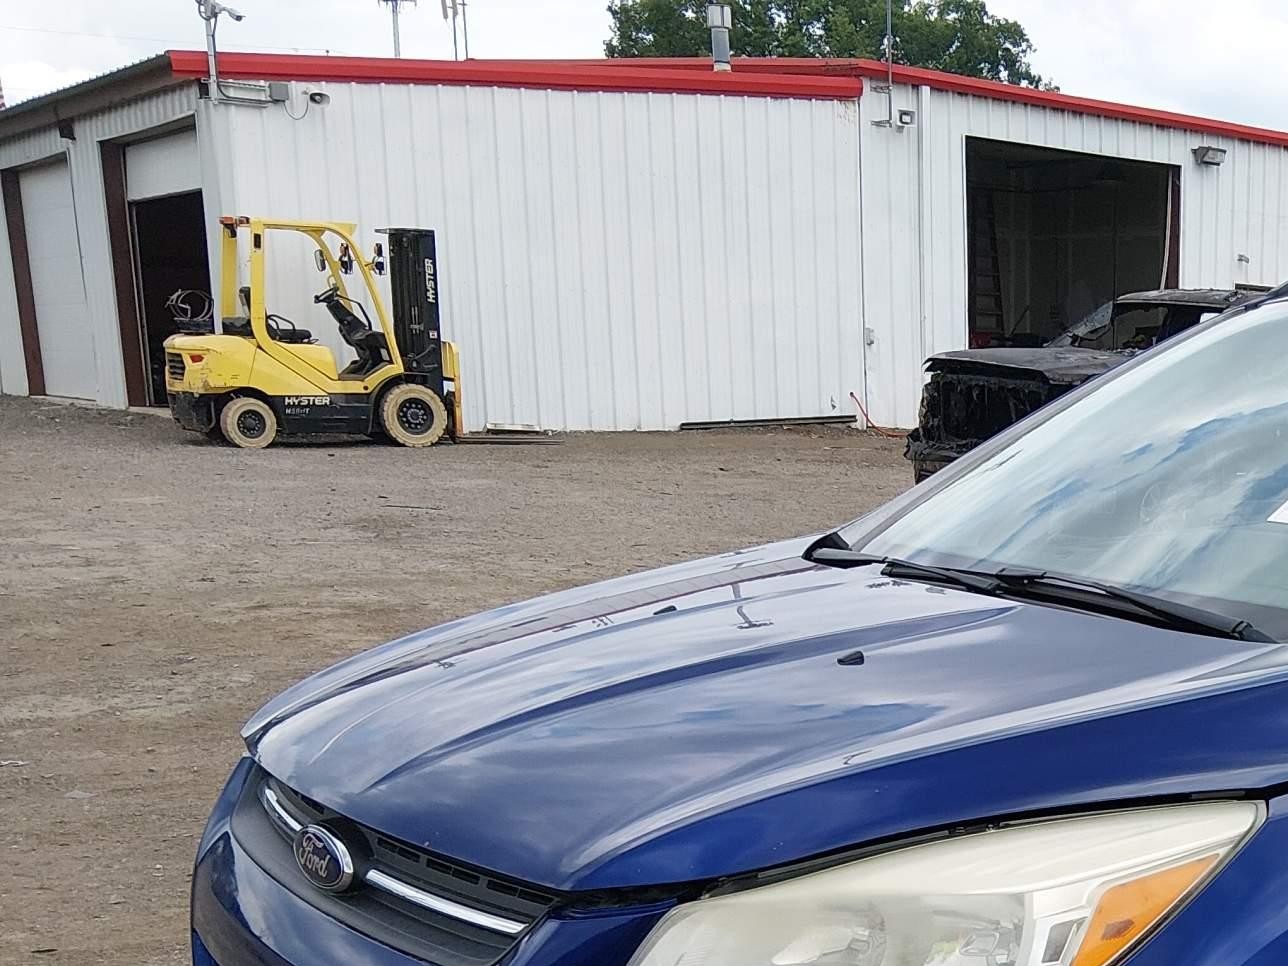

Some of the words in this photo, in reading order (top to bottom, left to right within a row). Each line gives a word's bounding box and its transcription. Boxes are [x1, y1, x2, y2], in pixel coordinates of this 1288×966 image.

[424, 258, 436, 303] HYSTER
[284, 396, 330, 406] HYSTER
[298, 833, 331, 878] Ford
